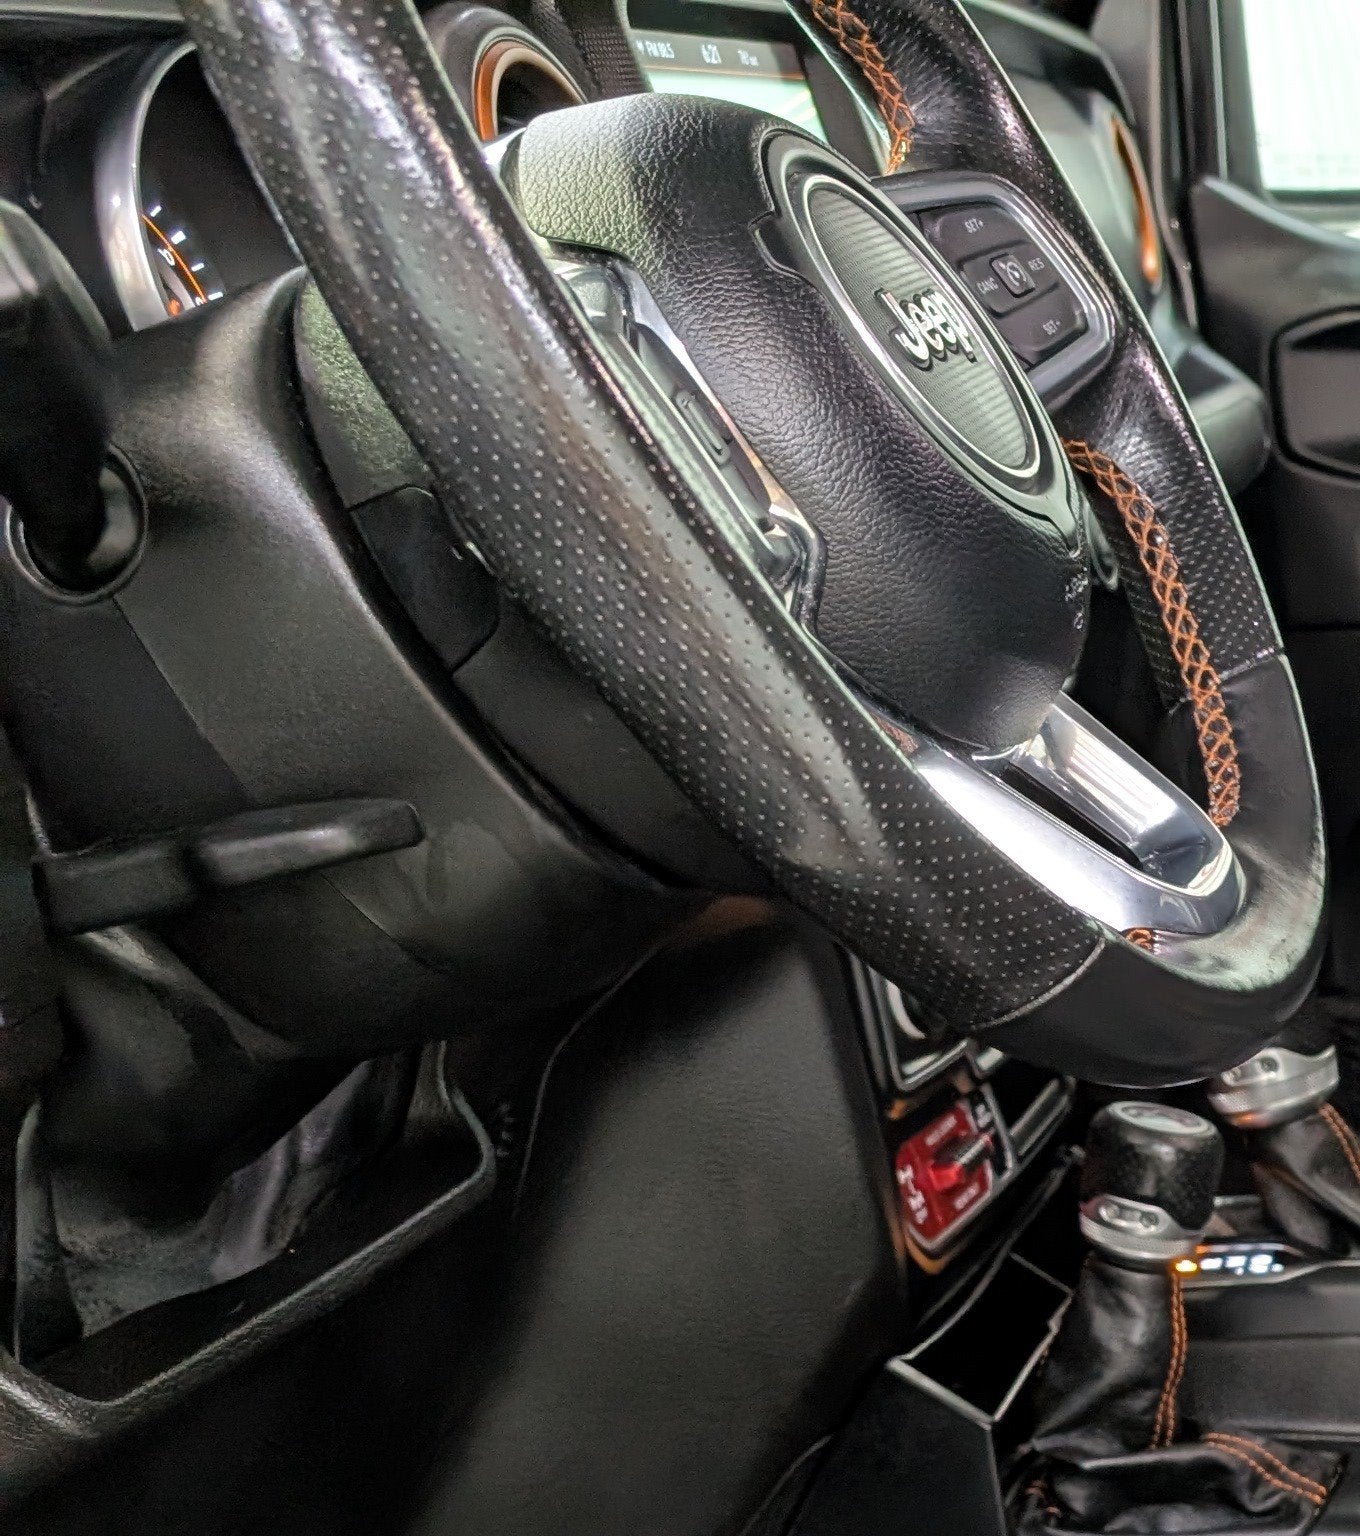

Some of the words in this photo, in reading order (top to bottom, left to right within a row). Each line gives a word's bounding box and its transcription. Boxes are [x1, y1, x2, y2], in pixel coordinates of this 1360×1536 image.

[1027, 257, 1045, 271] RES
[976, 277, 999, 294] CANC
[880, 290, 974, 361] Jeep
